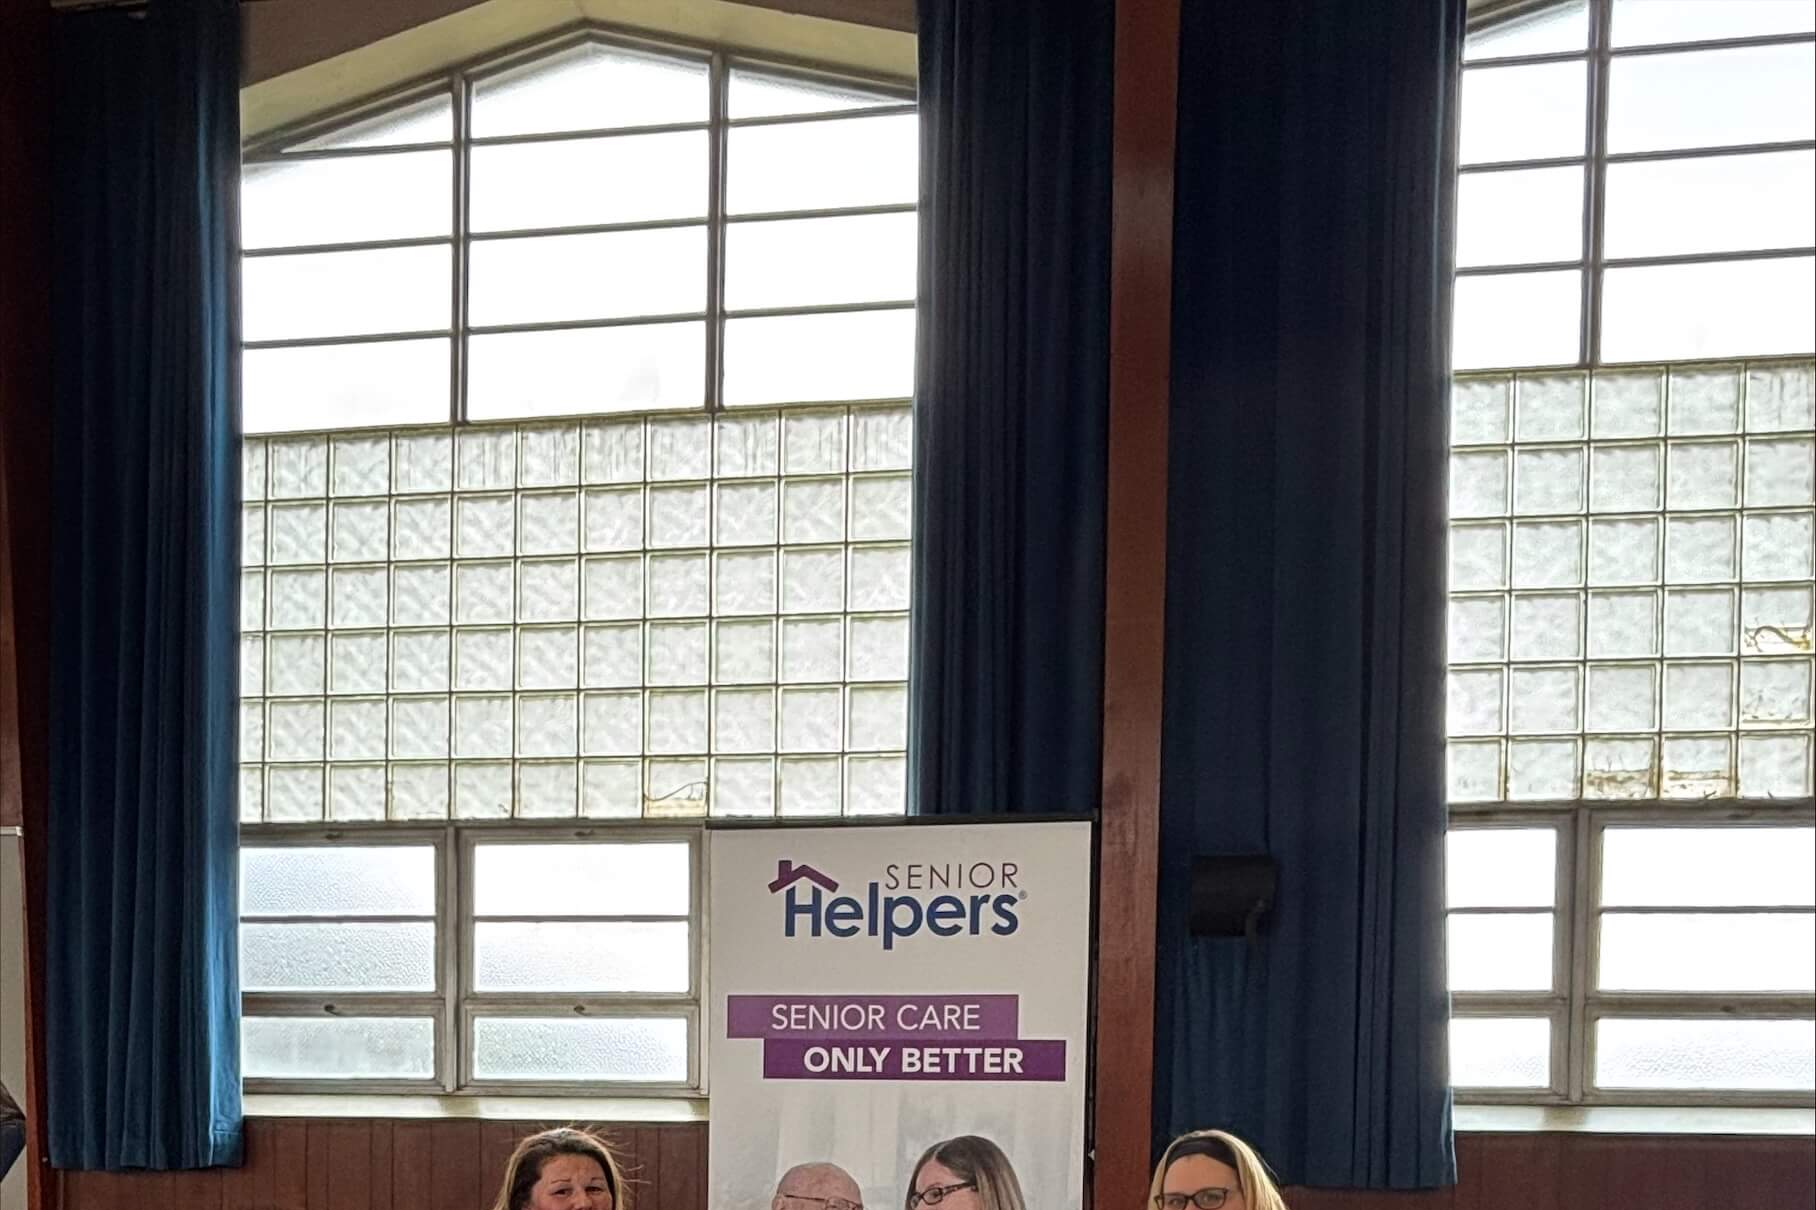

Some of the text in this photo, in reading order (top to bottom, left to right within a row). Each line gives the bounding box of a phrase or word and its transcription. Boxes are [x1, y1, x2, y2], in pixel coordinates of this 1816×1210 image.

[885, 862, 1019, 890] SENIOR
[771, 1003, 982, 1031] SENIOR CARE
[803, 1046, 1025, 1075] ONLY BETTER
